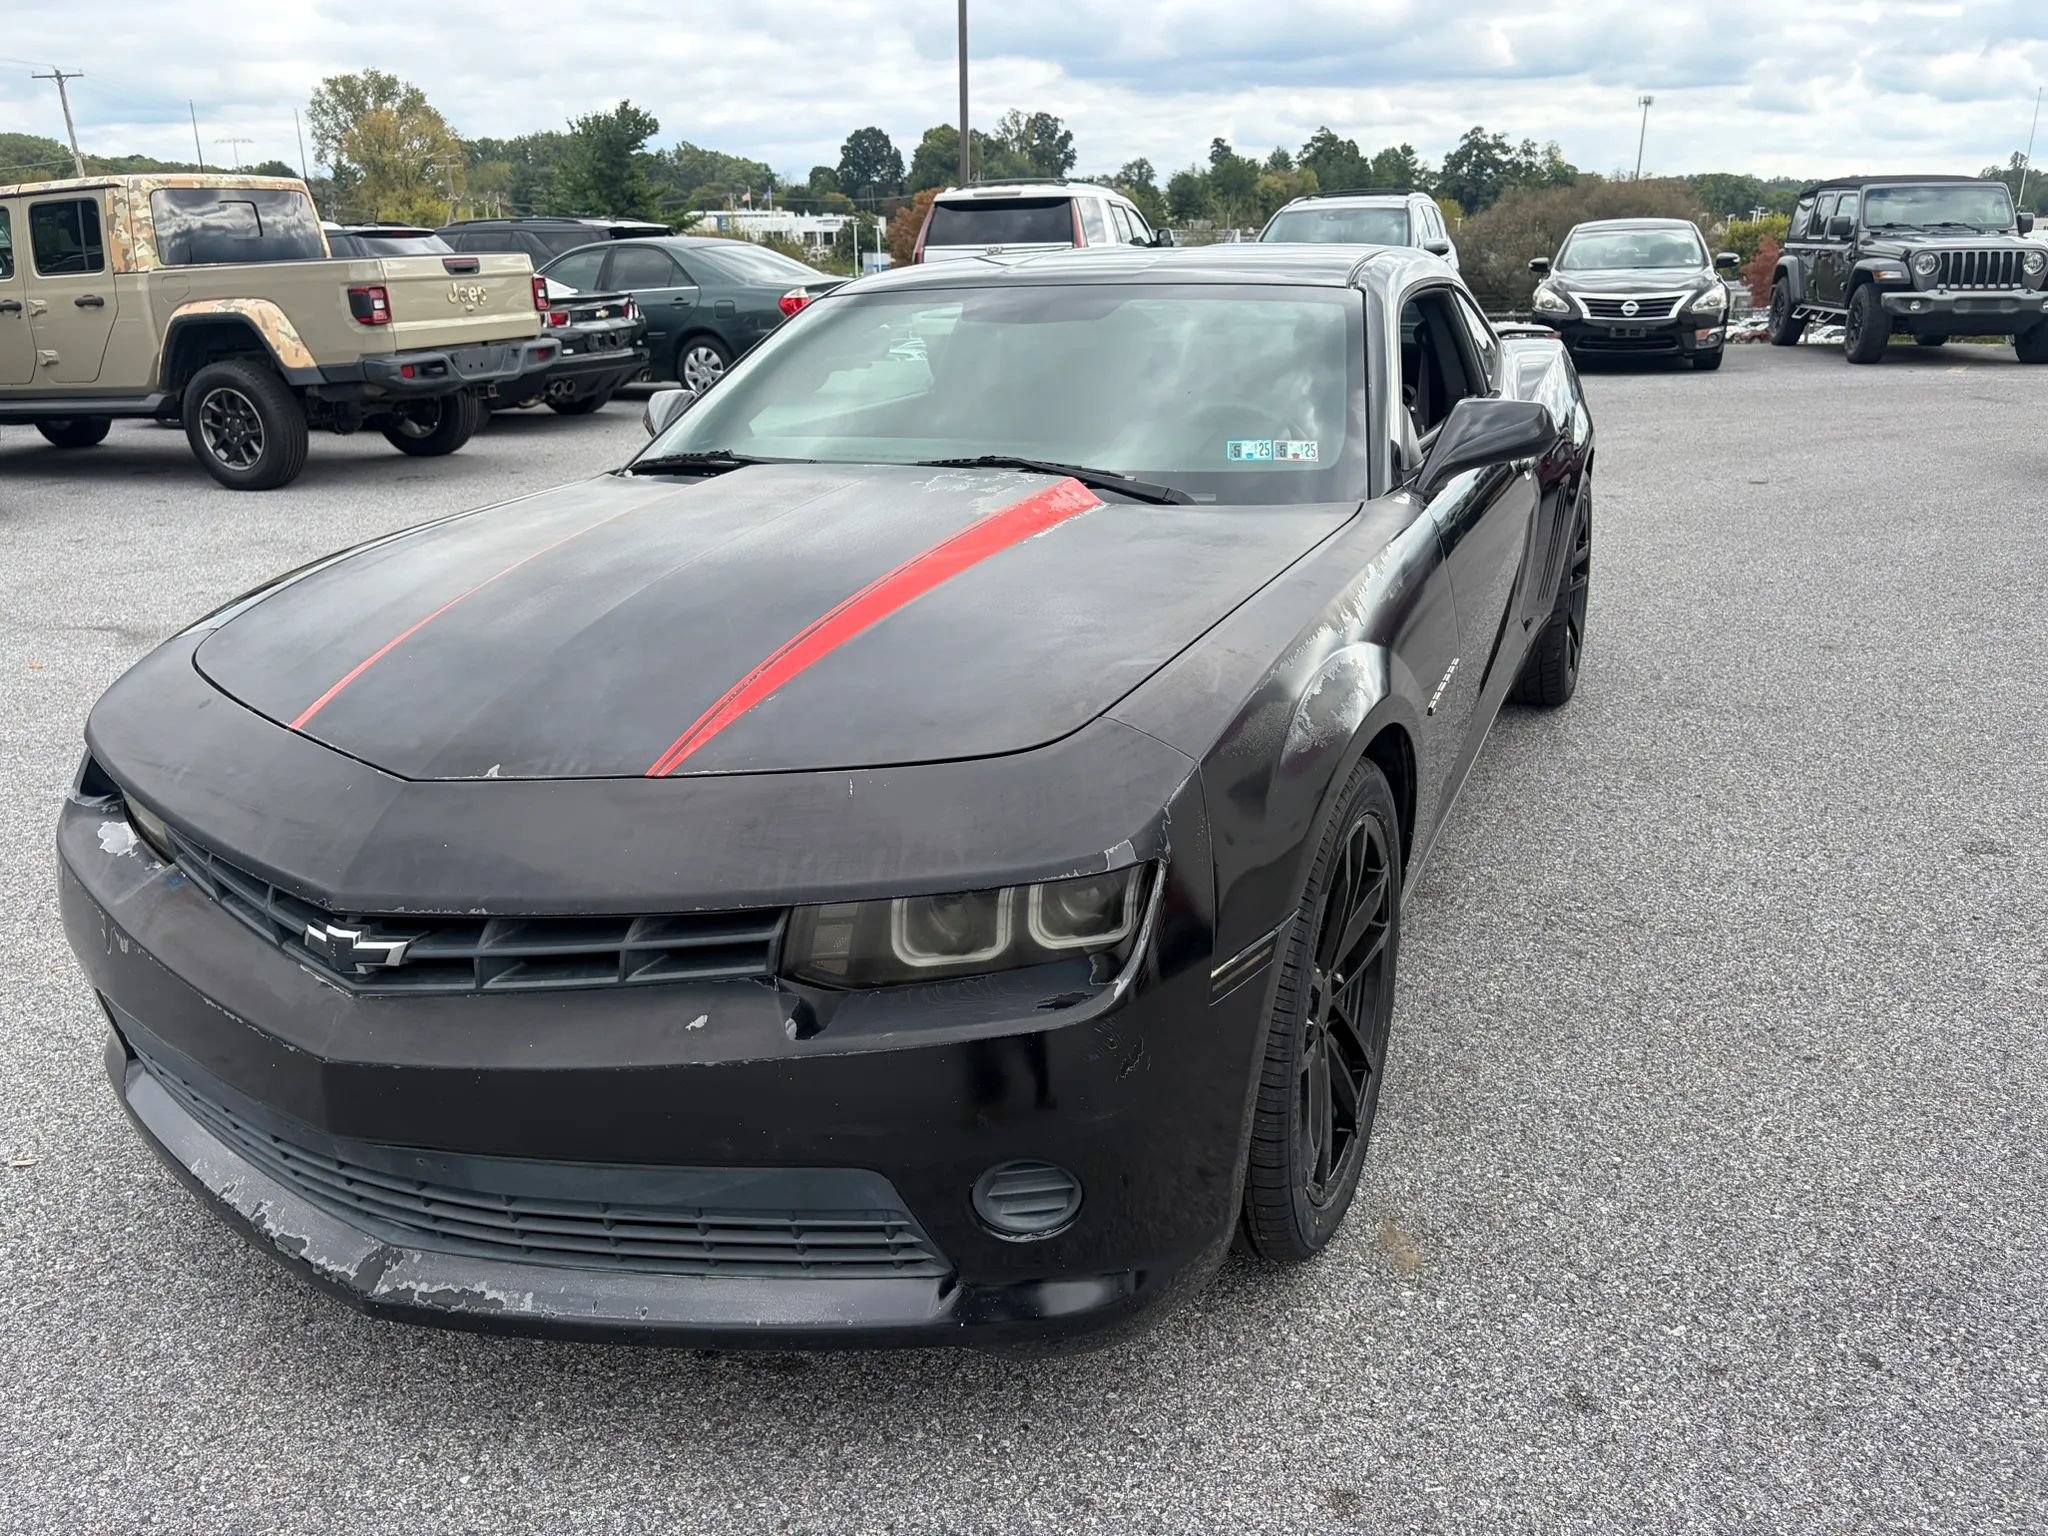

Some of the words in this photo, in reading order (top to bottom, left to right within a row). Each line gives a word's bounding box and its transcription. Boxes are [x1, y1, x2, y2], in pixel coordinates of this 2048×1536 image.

[446, 281, 487, 305] Jeep
[1233, 445, 1241, 458] 5
[1258, 442, 1270, 456] 25
[1305, 443, 1316, 457] 25
